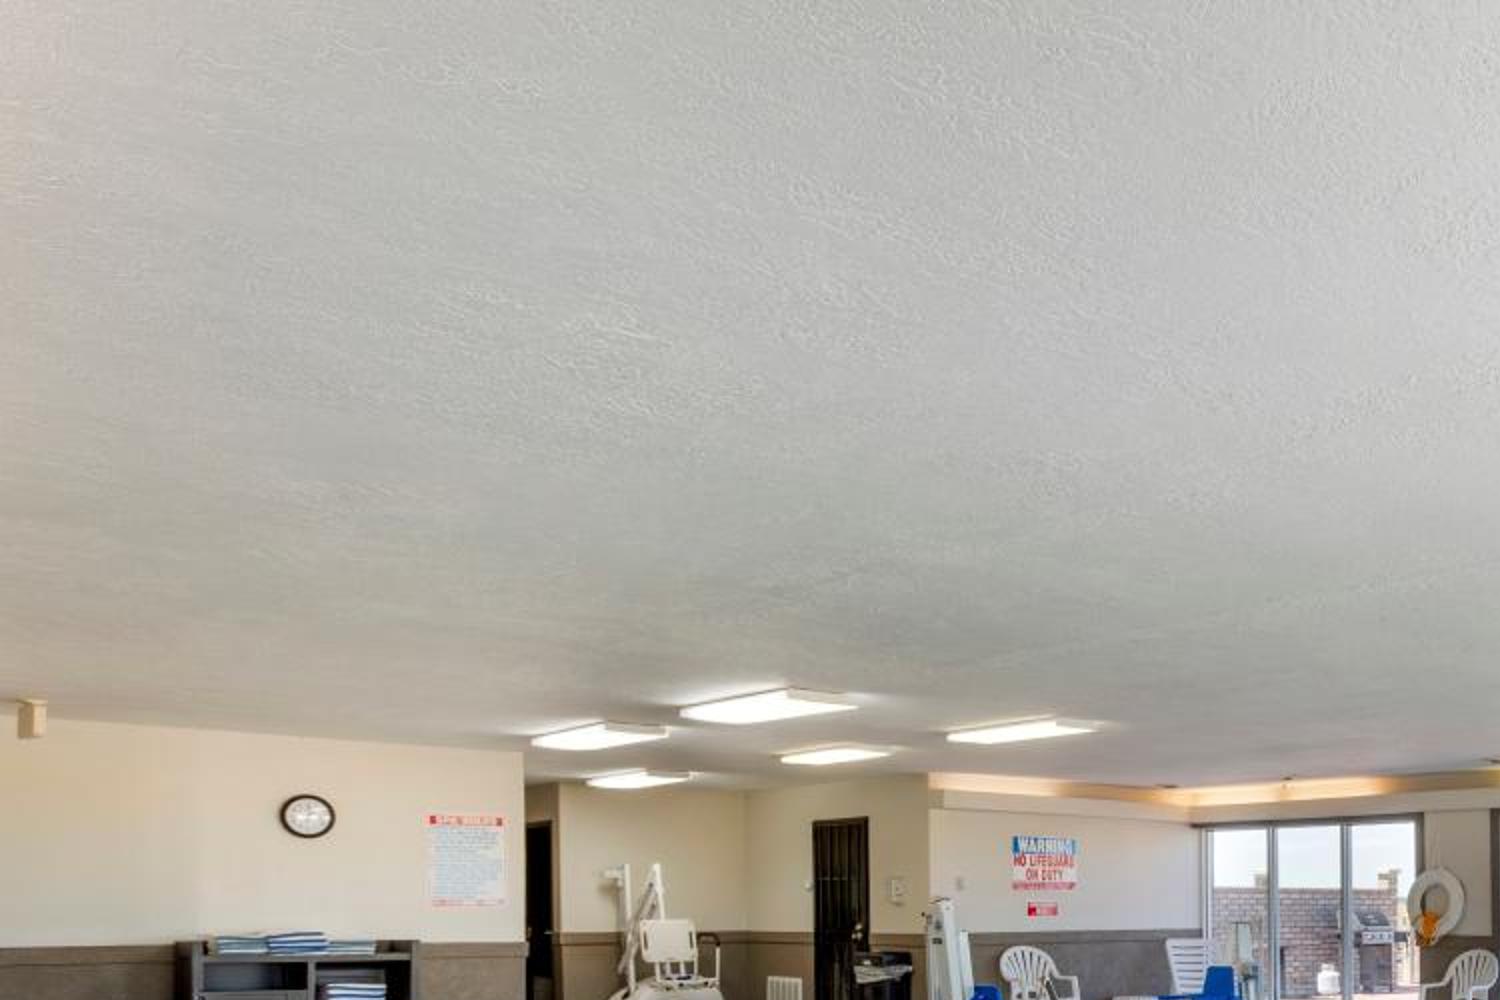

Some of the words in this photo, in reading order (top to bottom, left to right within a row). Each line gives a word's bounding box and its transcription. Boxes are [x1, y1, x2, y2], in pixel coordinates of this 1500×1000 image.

[1019, 837, 1073, 854] WARNING
[1013, 855, 1026, 867] NO
[1029, 855, 1075, 868] LIFEGUARD
[1025, 869, 1038, 880] ON
[1041, 869, 1063, 880] DUTY
